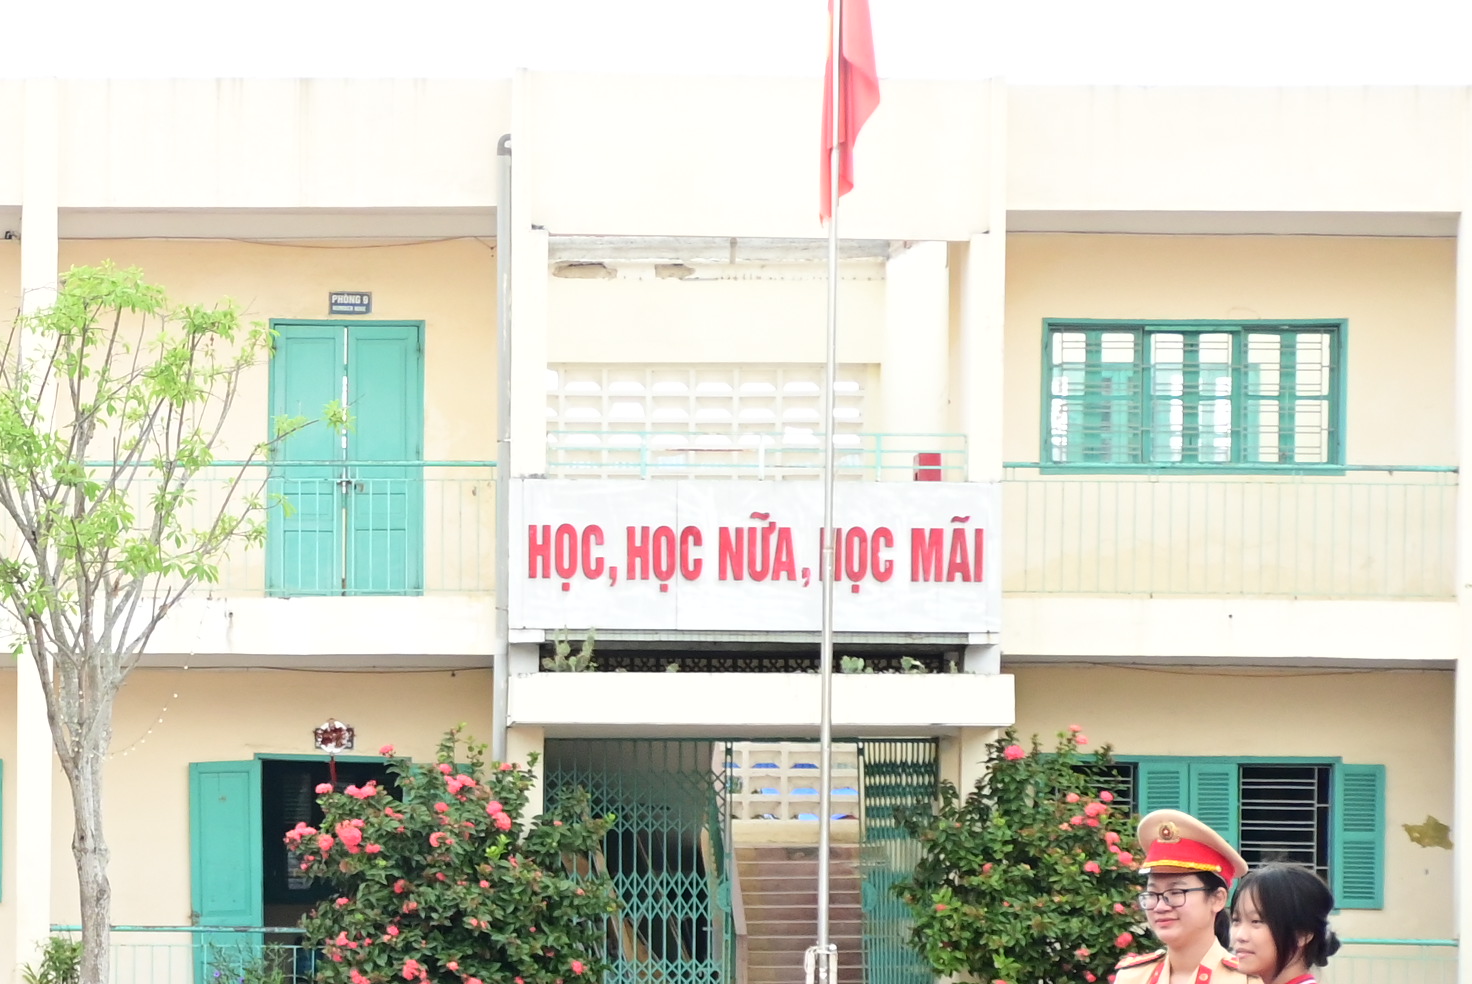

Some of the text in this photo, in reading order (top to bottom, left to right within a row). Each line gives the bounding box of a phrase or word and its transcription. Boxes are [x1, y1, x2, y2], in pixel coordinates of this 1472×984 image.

[331, 293, 361, 304] PHÒNG
[528, 523, 618, 592] HỌC,
[627, 524, 704, 593] HỌC
[718, 511, 811, 588] NỮA,
[911, 516, 985, 583] MÃI
